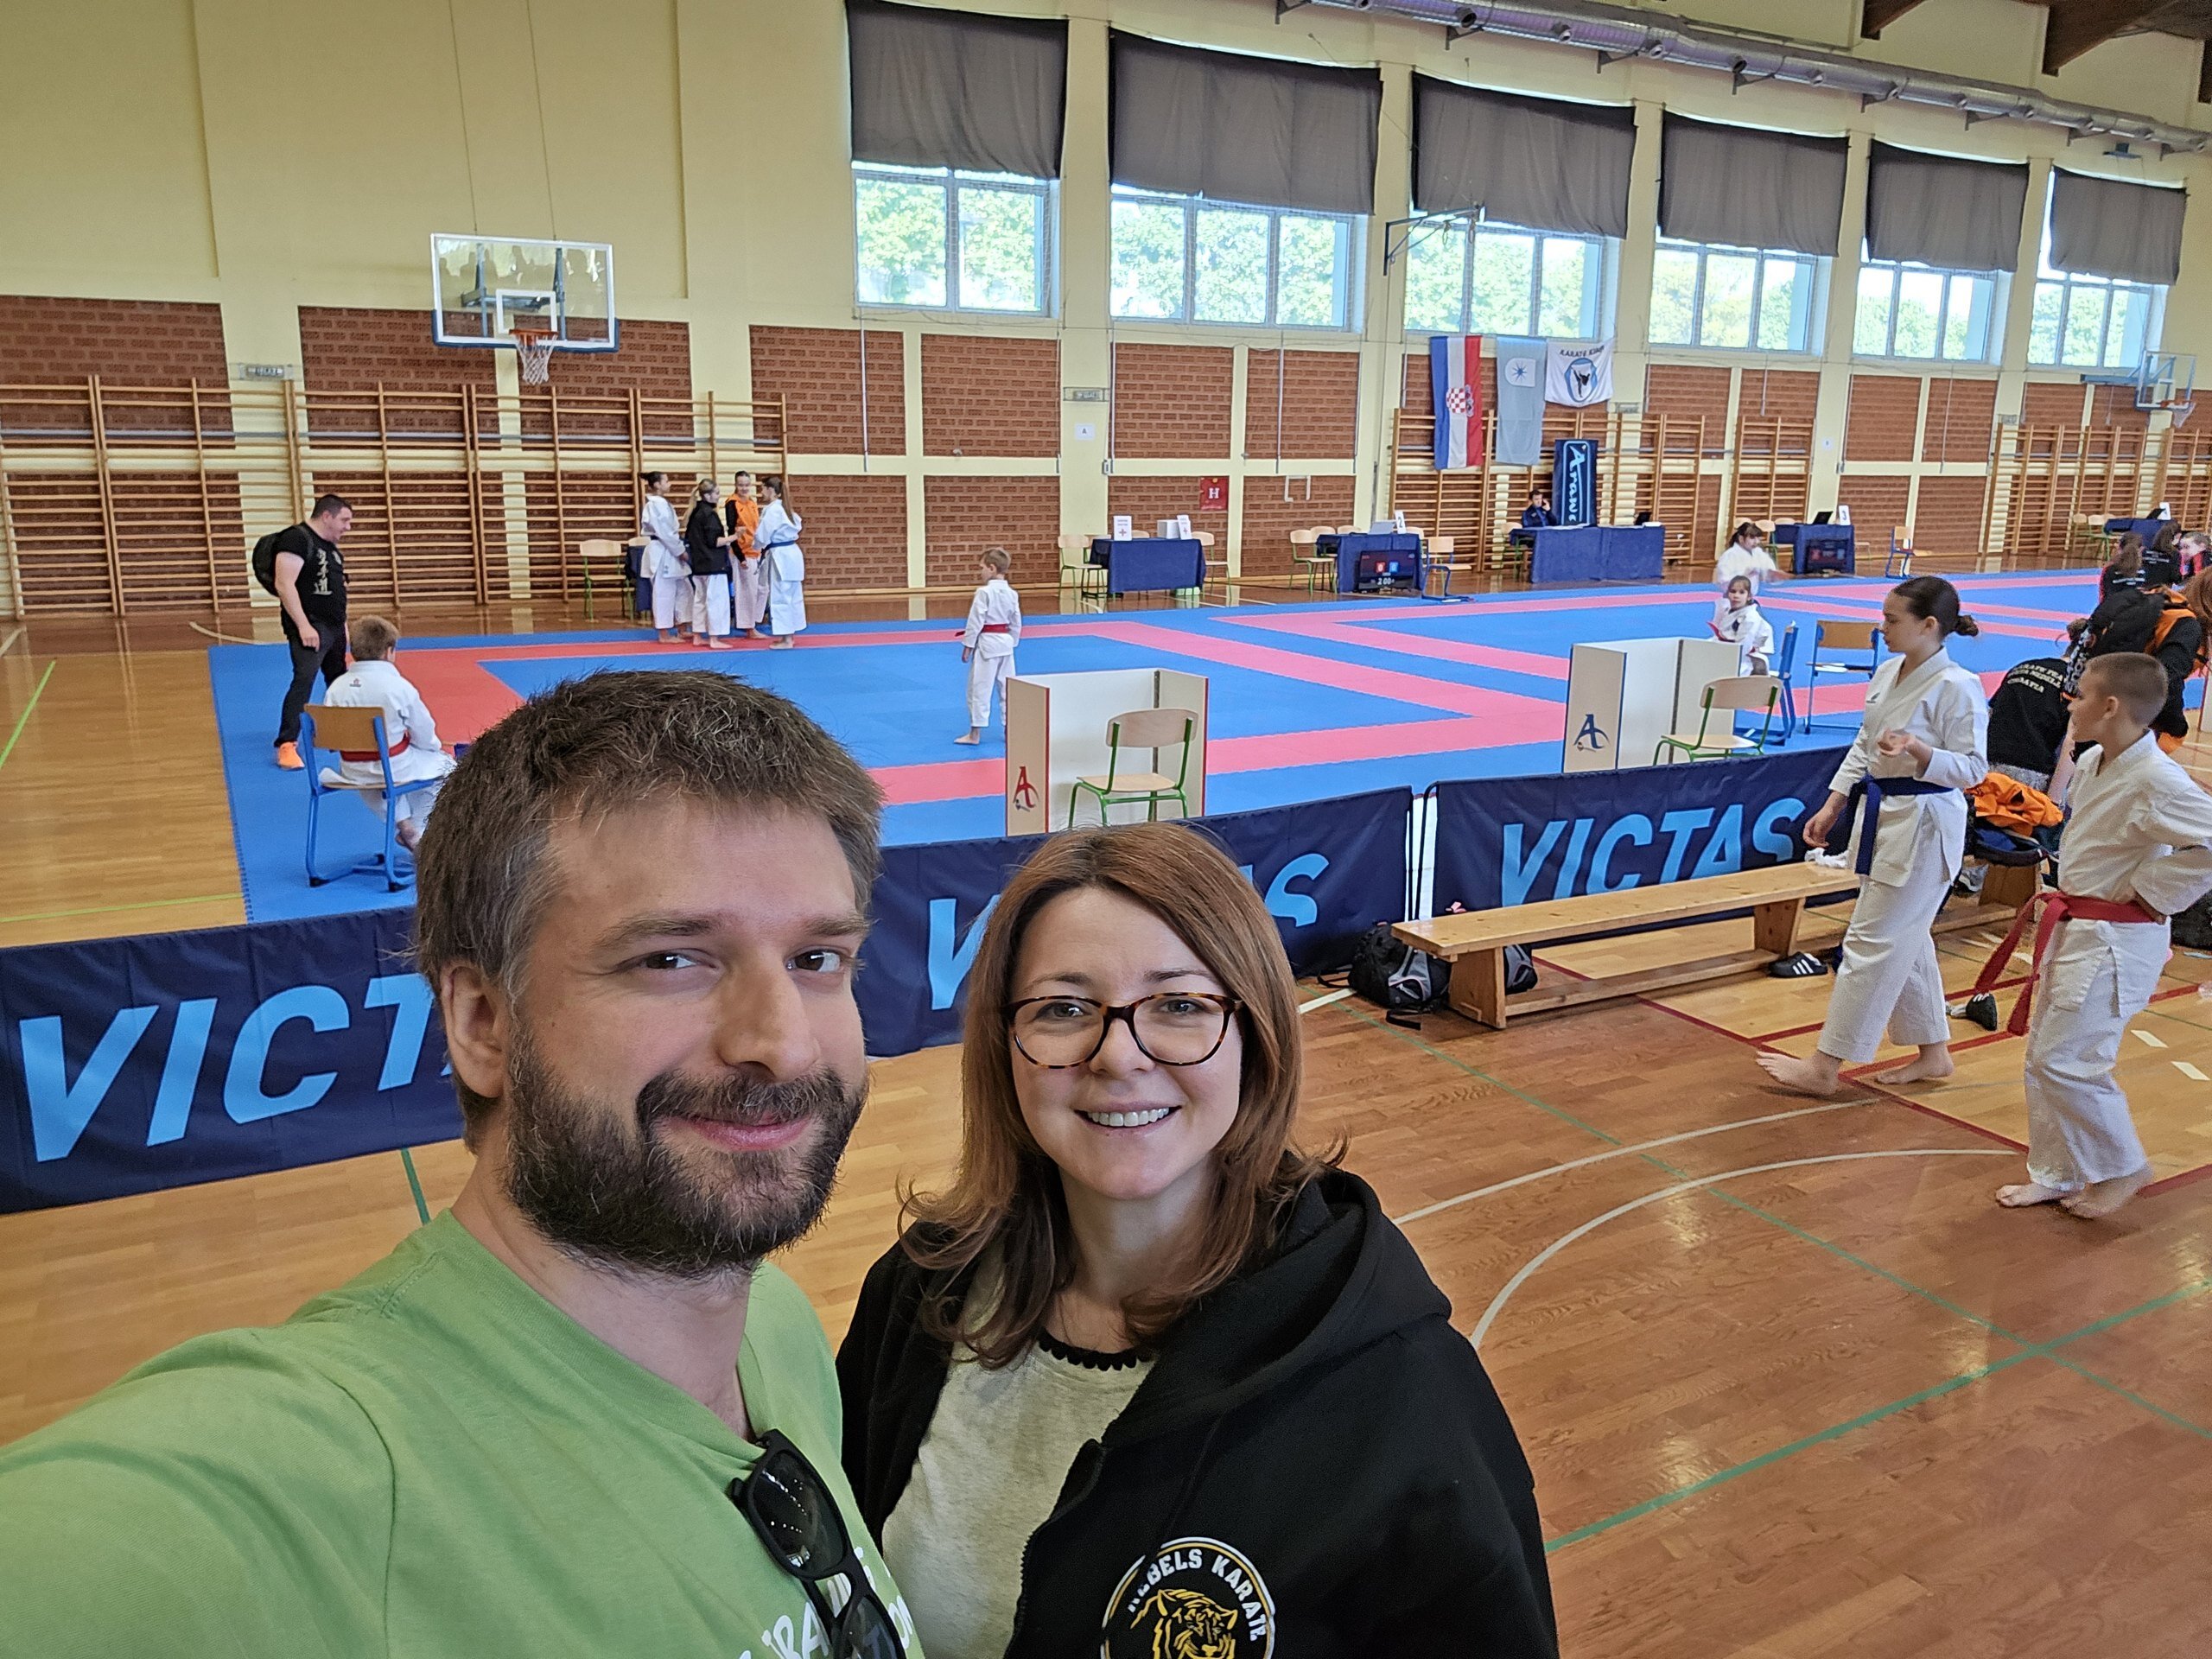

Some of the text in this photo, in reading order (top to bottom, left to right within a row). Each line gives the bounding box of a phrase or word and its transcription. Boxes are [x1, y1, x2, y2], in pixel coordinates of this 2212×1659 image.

[1208, 487, 1220, 499] H
[1397, 517, 1403, 528] 2
[1500, 798, 1807, 907] VICTAS
[19, 972, 454, 1163] VICT
[1211, 1555, 1267, 1642] KARATE
